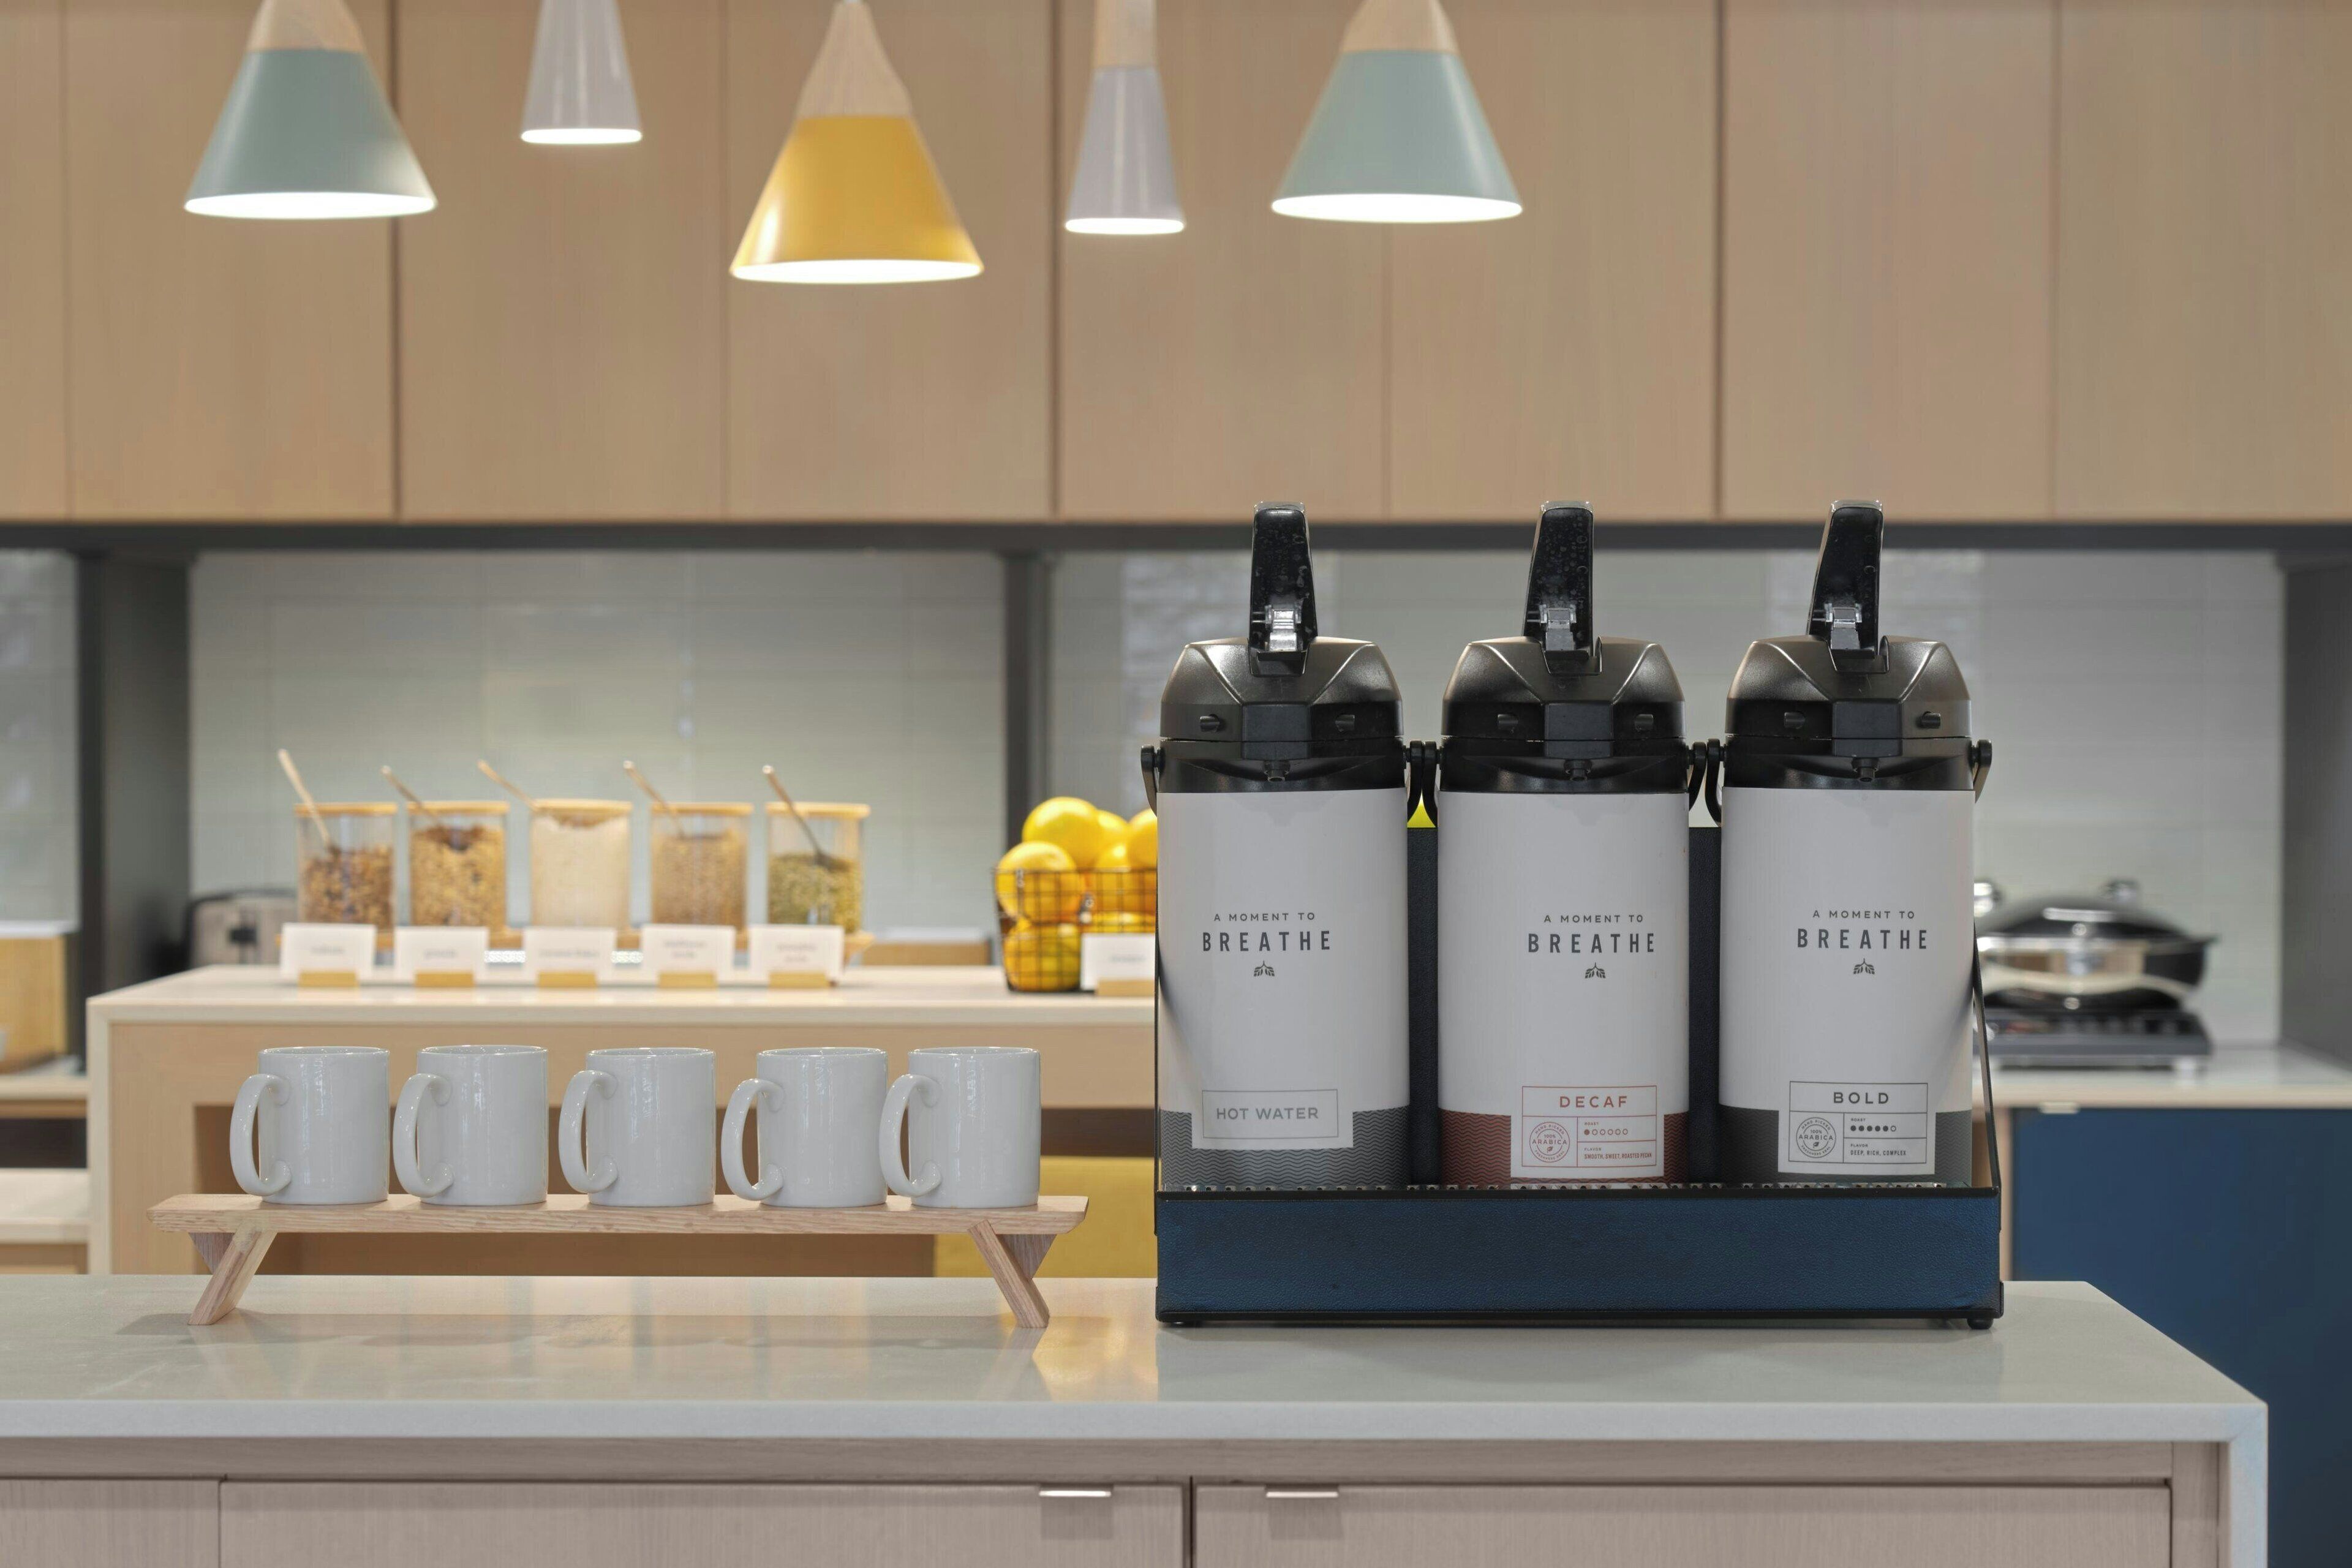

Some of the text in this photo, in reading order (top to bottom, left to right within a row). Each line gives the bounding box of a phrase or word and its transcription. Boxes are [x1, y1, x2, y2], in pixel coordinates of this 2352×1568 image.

[1229, 913, 1289, 921] MOMENT
[1813, 910, 1820, 918] A
[1829, 910, 1891, 919] MOMENT
[1202, 930, 1330, 951] BREATHE
[1528, 933, 1654, 953] BREATHE
[1797, 928, 1927, 949] BREATHE
[1559, 1096, 1627, 1107] DECAF
[1833, 1091, 1889, 1104] BOLD
[1216, 1107, 1319, 1120] HOT WATER
